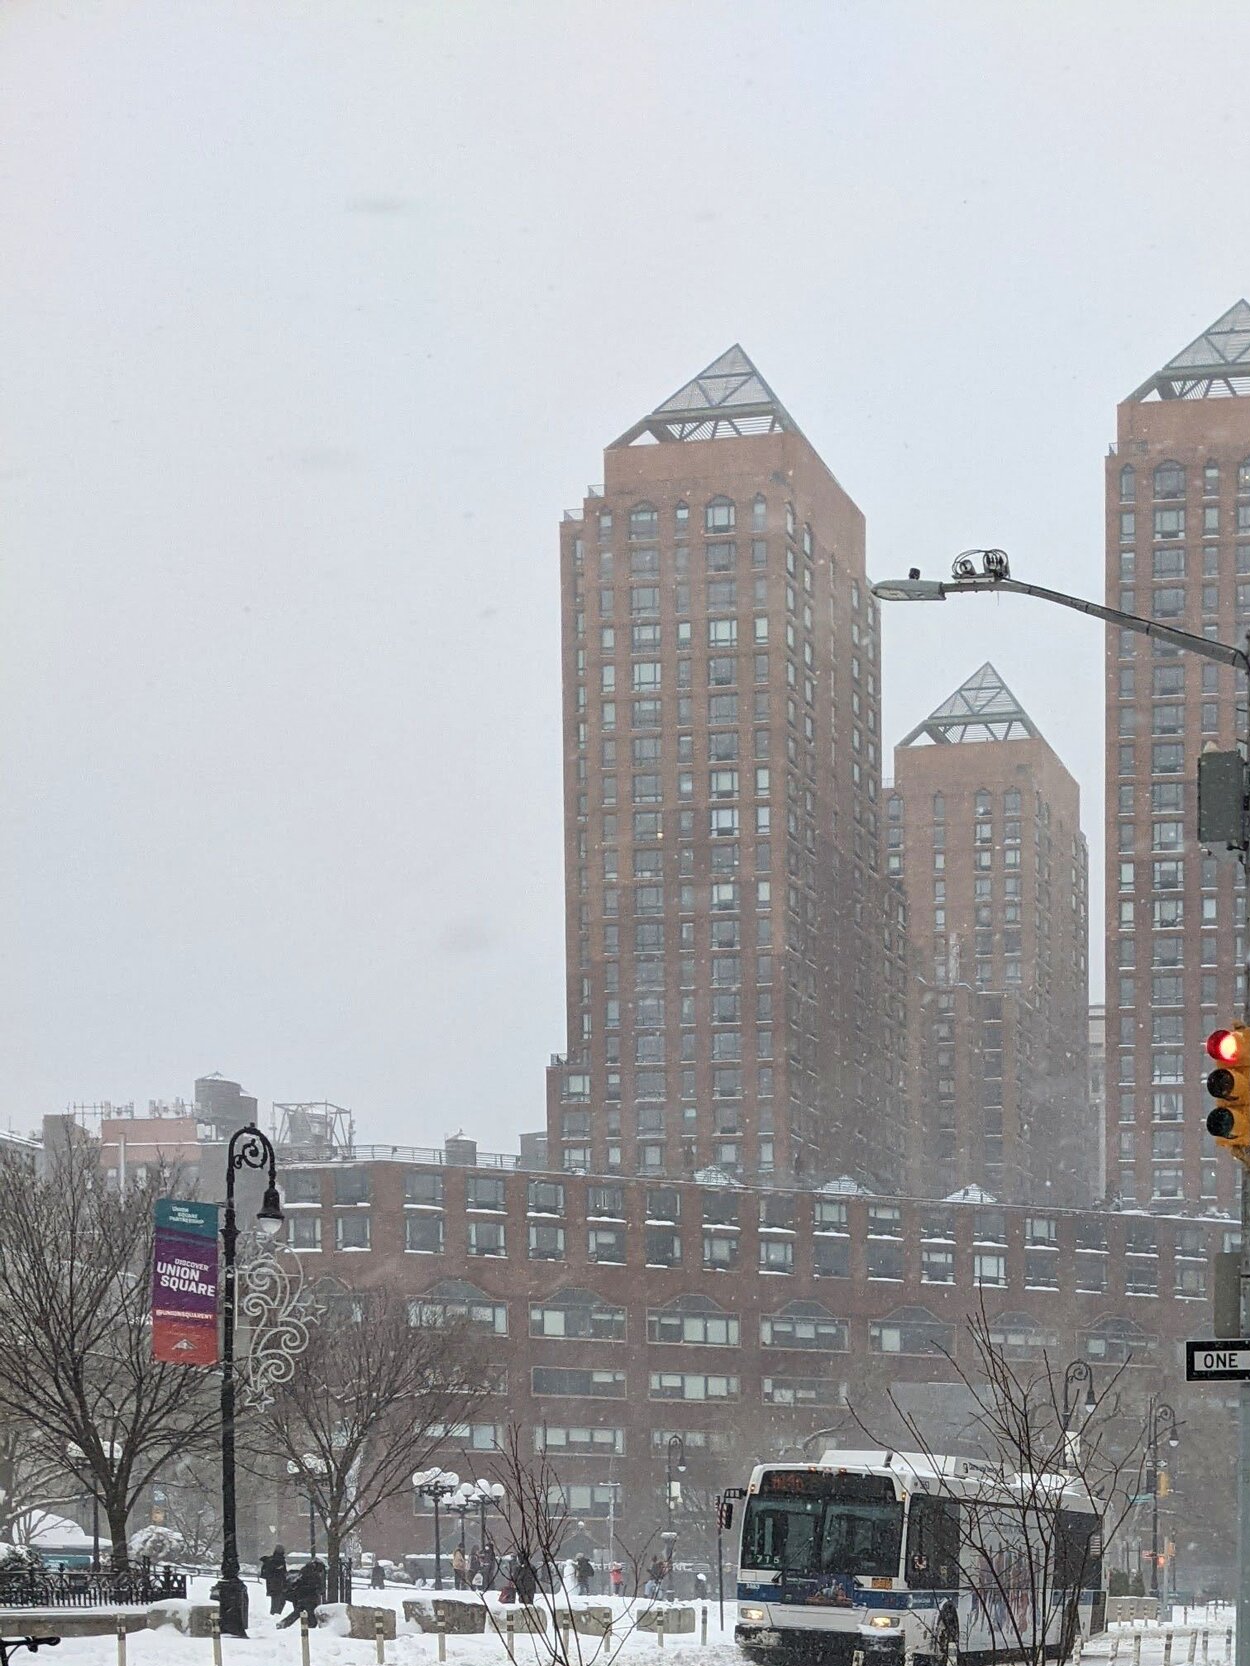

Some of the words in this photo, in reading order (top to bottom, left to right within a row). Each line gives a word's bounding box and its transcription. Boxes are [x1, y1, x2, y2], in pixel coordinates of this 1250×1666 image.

[156, 1261, 200, 1282] UNION
[174, 1258, 209, 1272] DISCOVER
[160, 1275, 216, 1297] SQUARE
[1203, 1353, 1238, 1369] ONE
